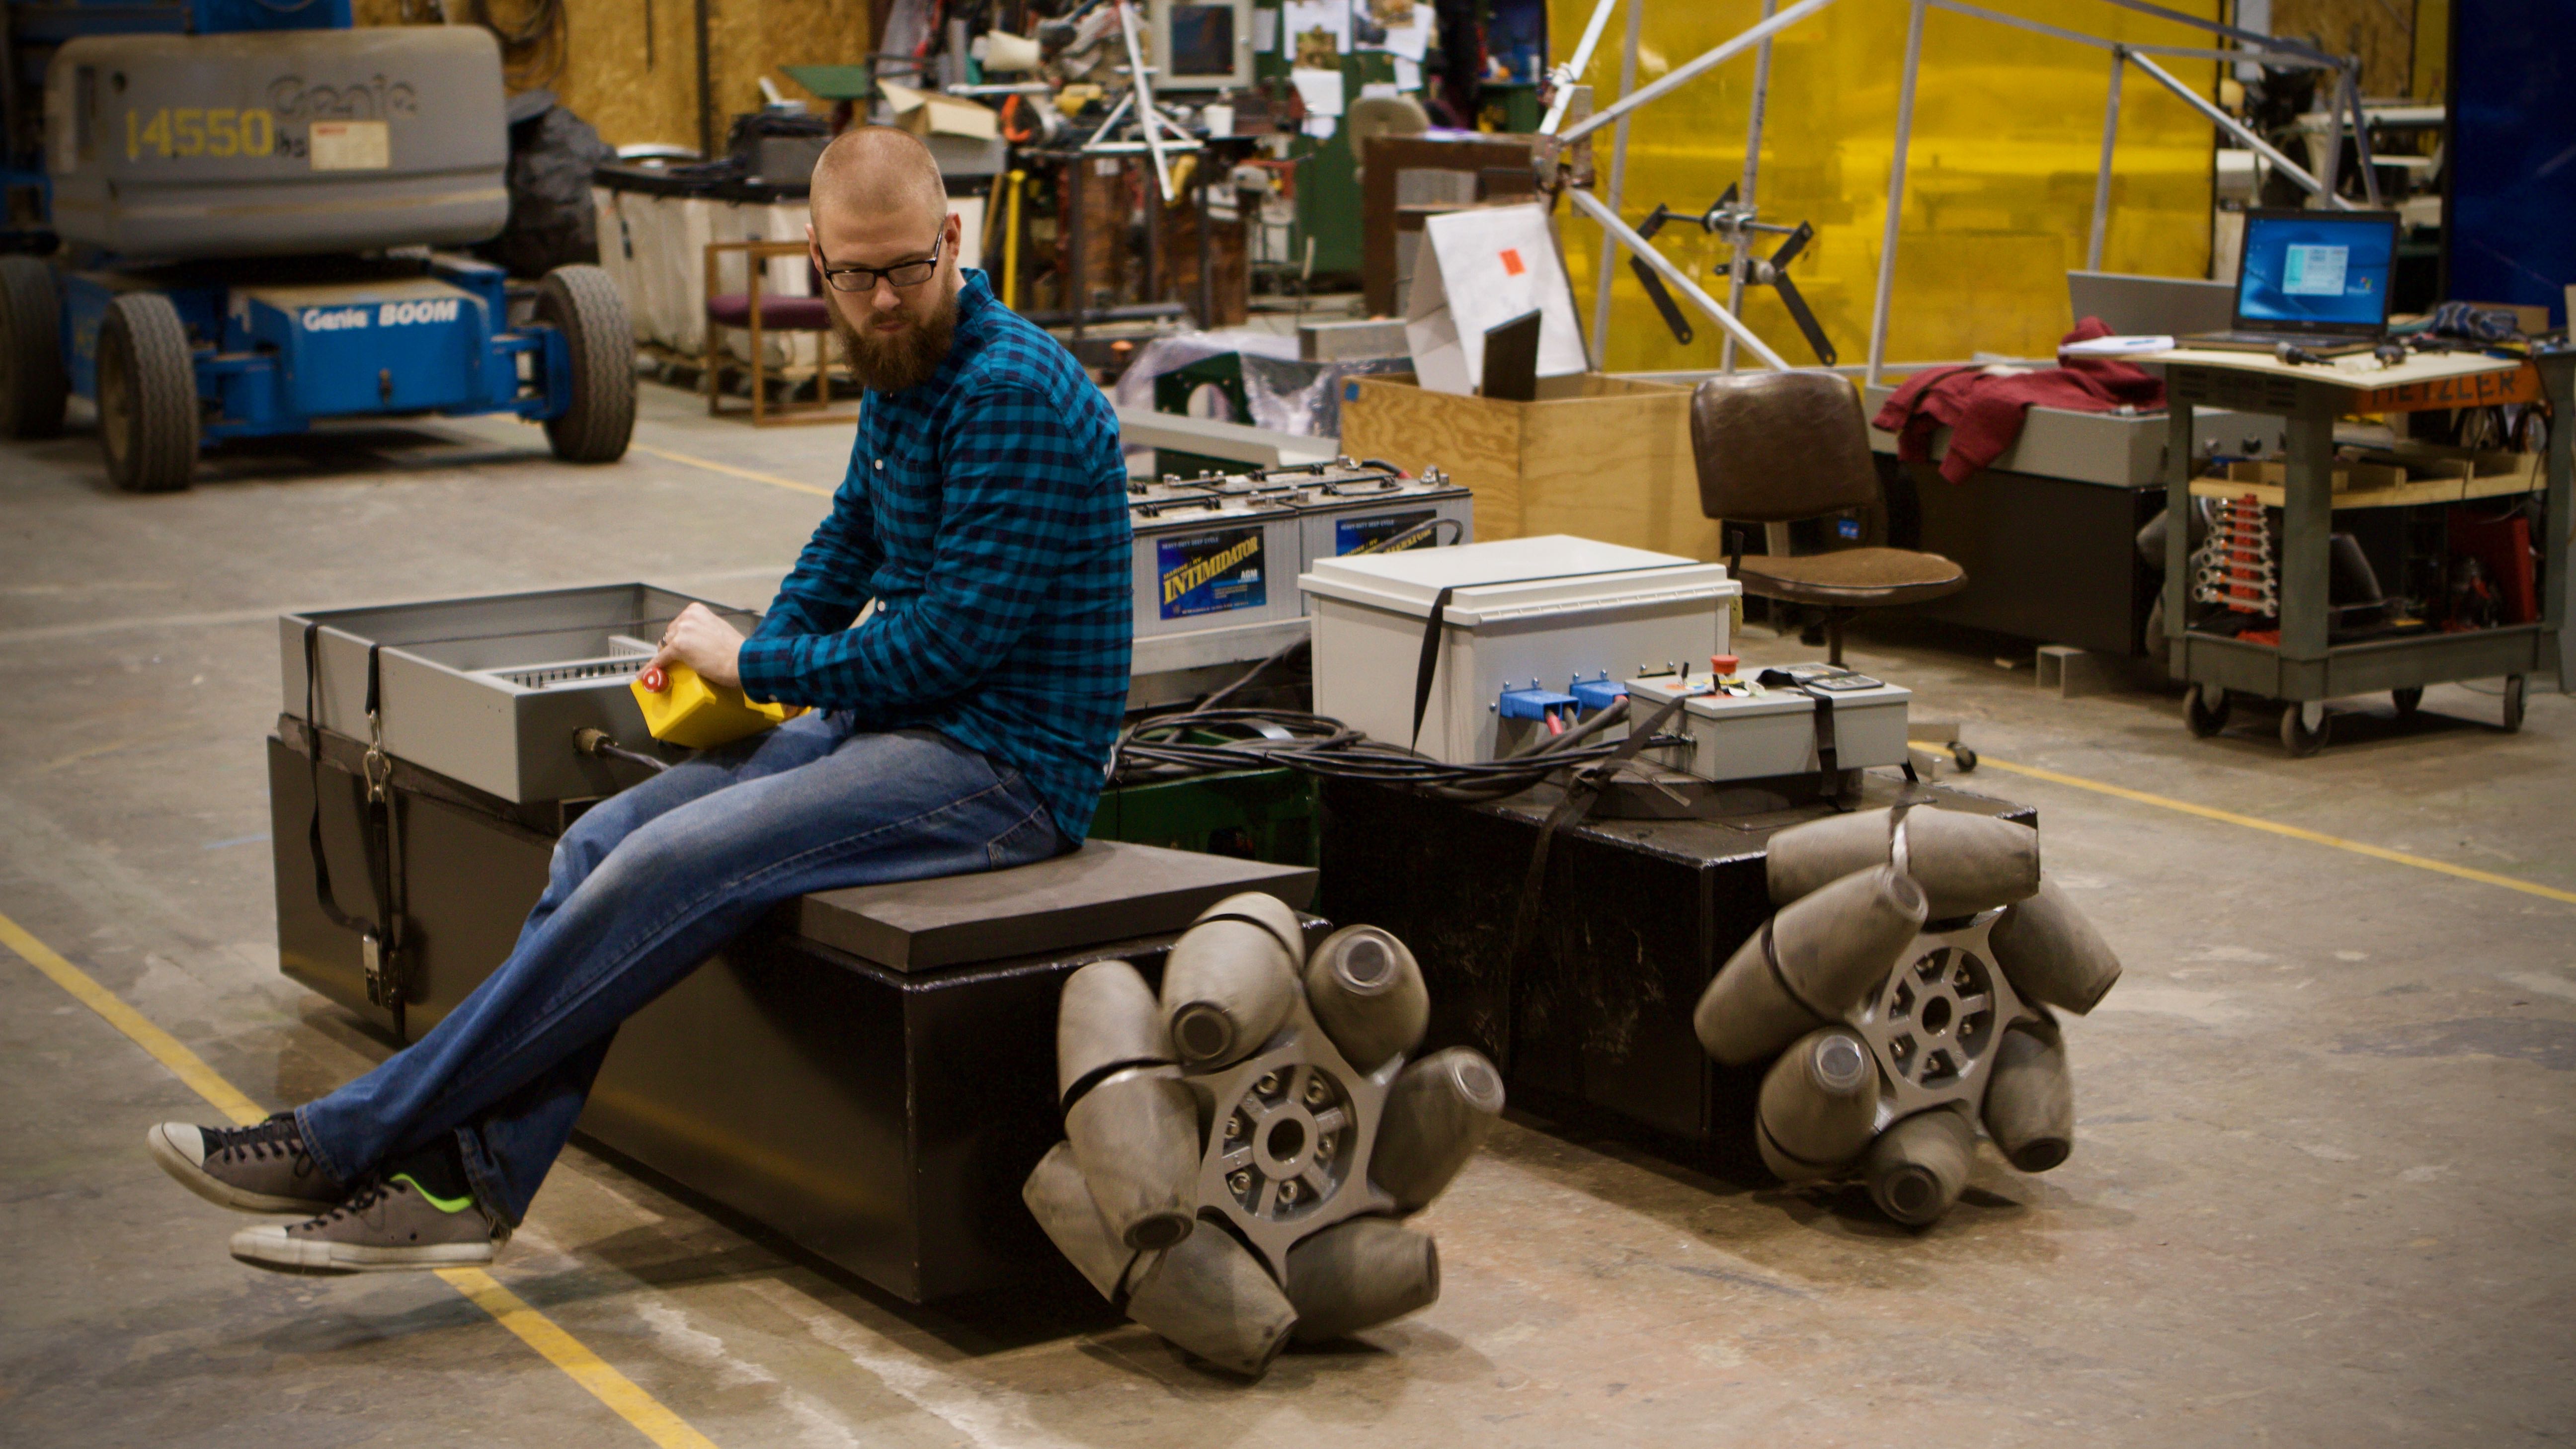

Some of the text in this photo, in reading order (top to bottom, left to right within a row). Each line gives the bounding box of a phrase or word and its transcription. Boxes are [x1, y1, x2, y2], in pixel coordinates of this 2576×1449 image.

[267, 73, 416, 120] Genie
[125, 107, 274, 157] 14550
[303, 299, 458, 332] Genie BOOM
[1163, 536, 1258, 605] INTIMIDATOR
[1241, 568, 1258, 581] AGM
